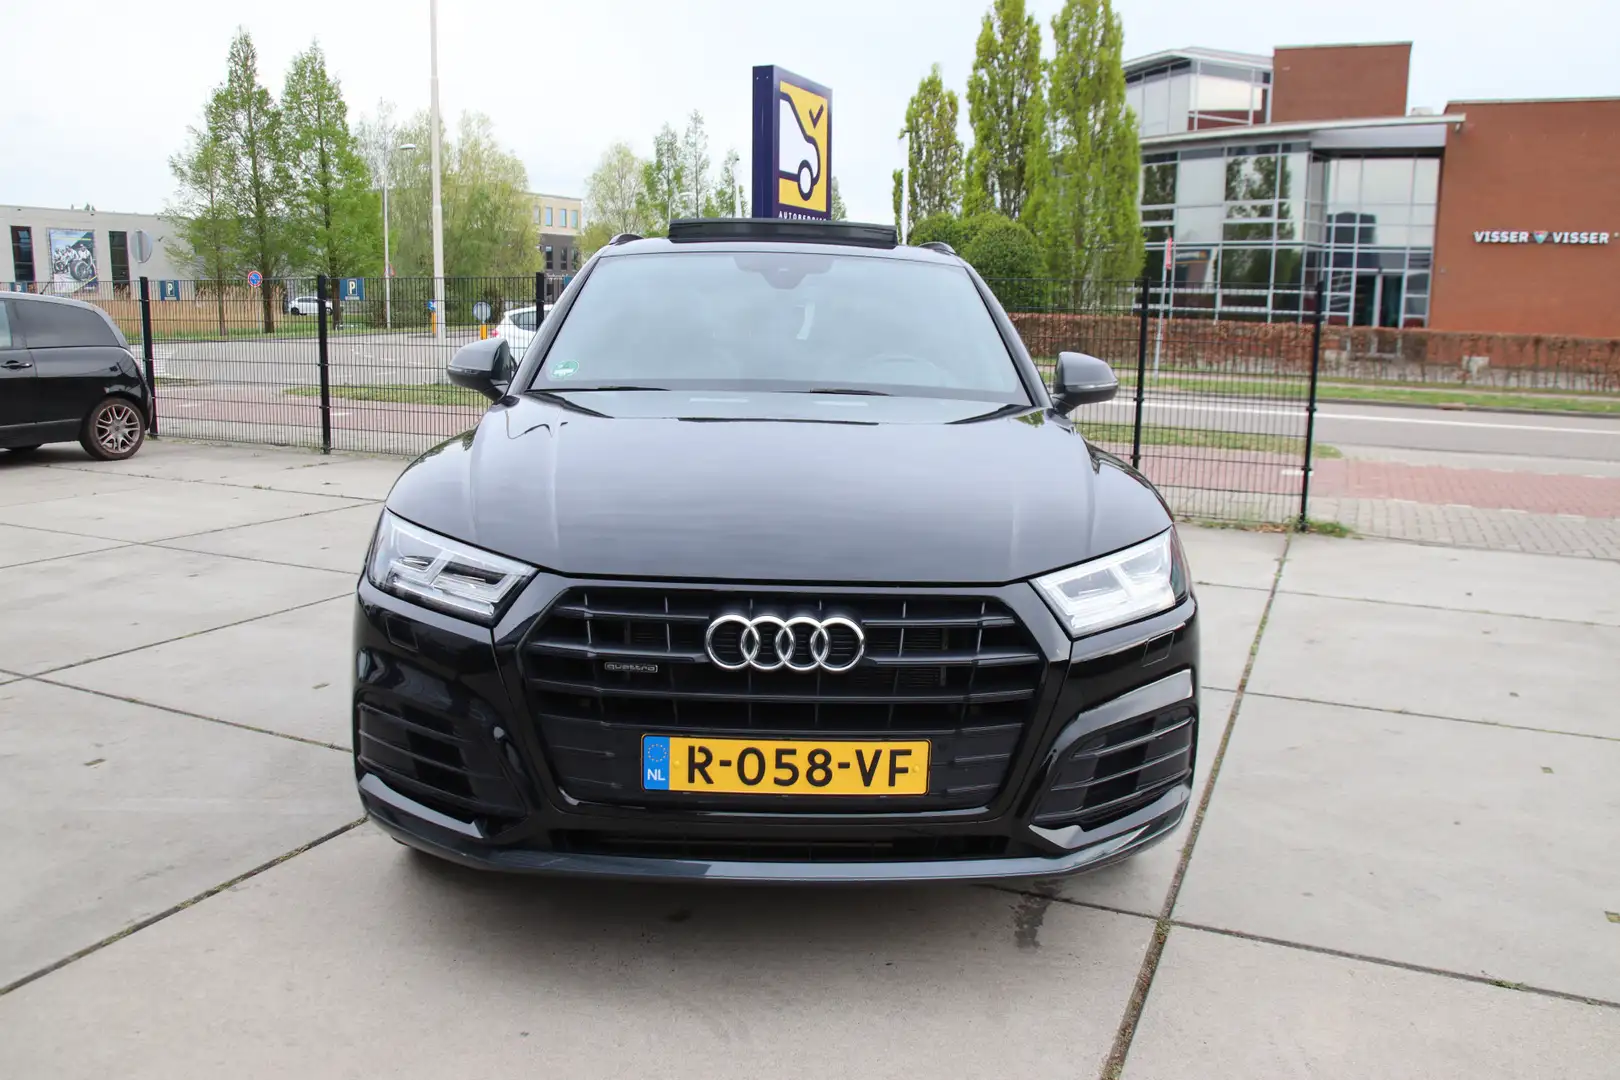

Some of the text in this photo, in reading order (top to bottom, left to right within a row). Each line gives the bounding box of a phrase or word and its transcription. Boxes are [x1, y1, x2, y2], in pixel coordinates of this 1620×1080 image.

[778, 210, 827, 220] AUTOBED
[1473, 231, 1610, 244] VISSER VISSER
[349, 281, 356, 295] P
[606, 663, 657, 672] quattro
[687, 745, 912, 787] R-058-VF
[647, 768, 666, 782] NL
